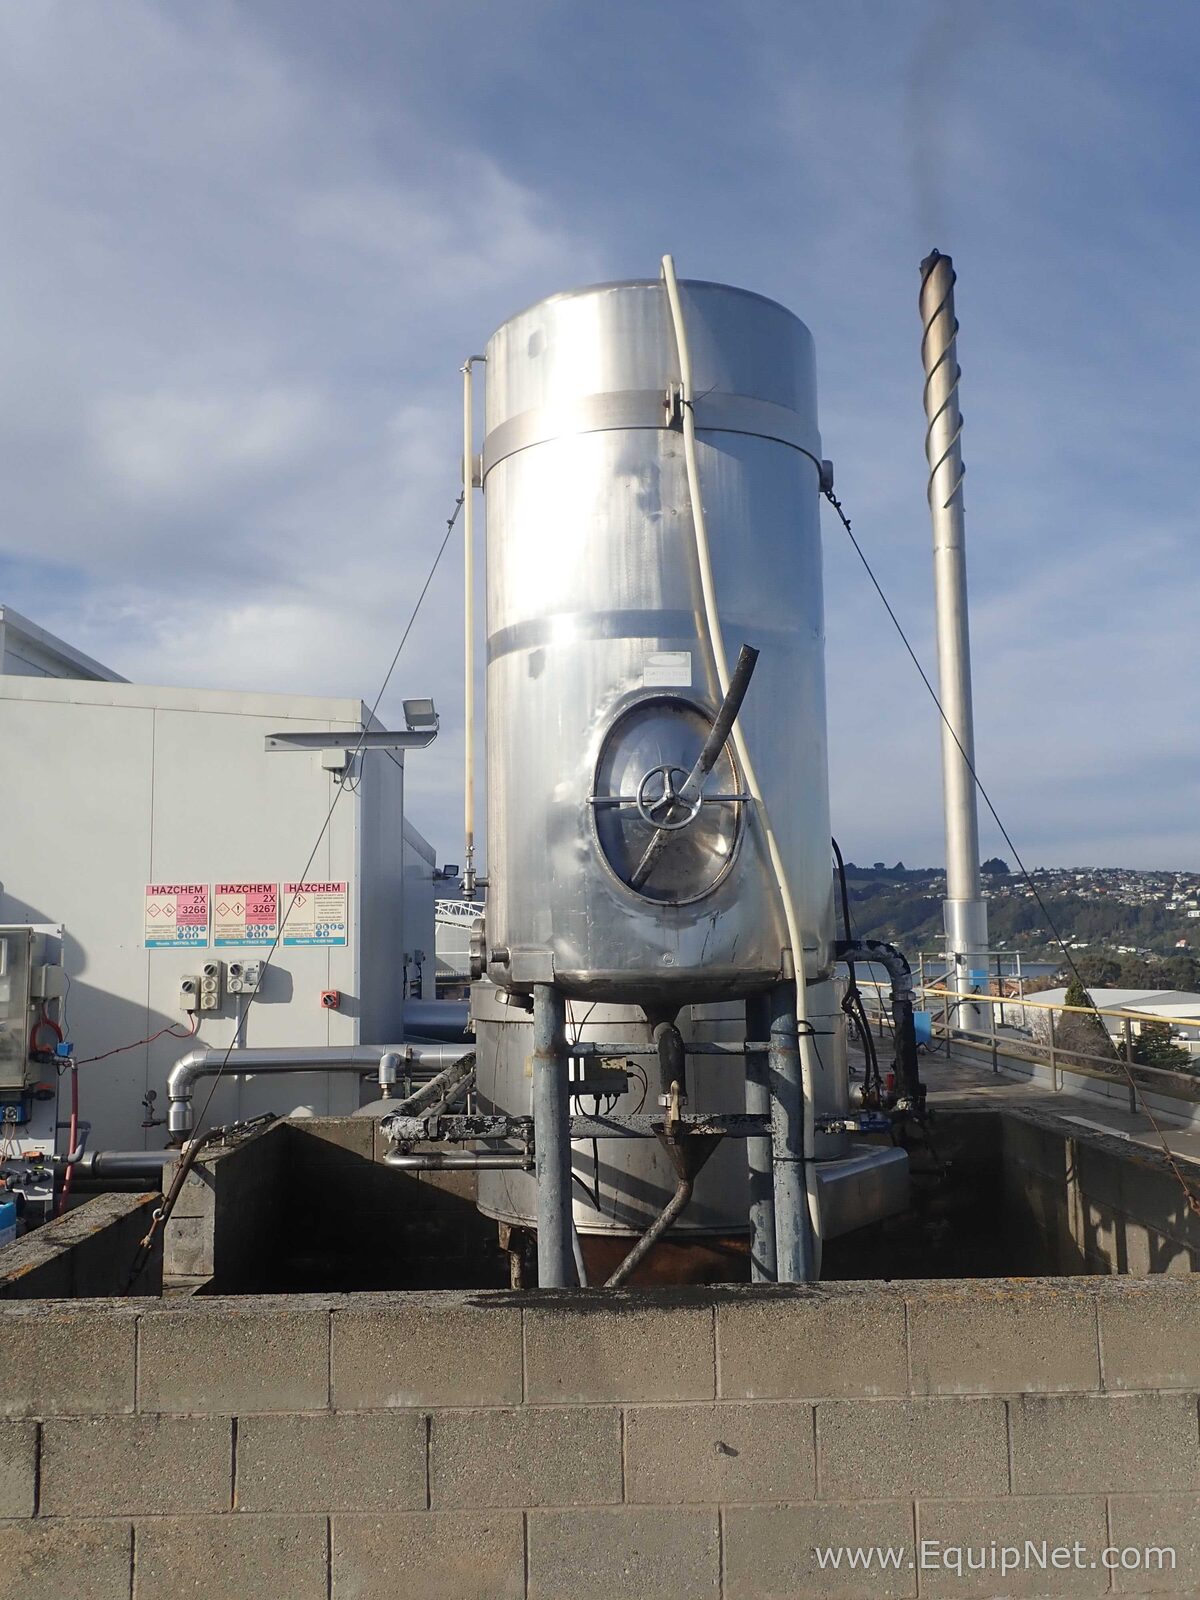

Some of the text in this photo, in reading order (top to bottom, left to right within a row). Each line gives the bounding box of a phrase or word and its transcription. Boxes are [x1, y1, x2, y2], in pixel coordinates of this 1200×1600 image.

[152, 886, 203, 894] HAZCHEM
[220, 885, 272, 893] HAZCHEM
[289, 884, 341, 892] HAZCHEM
[182, 906, 206, 914] 3266
[253, 905, 276, 913] 3267
